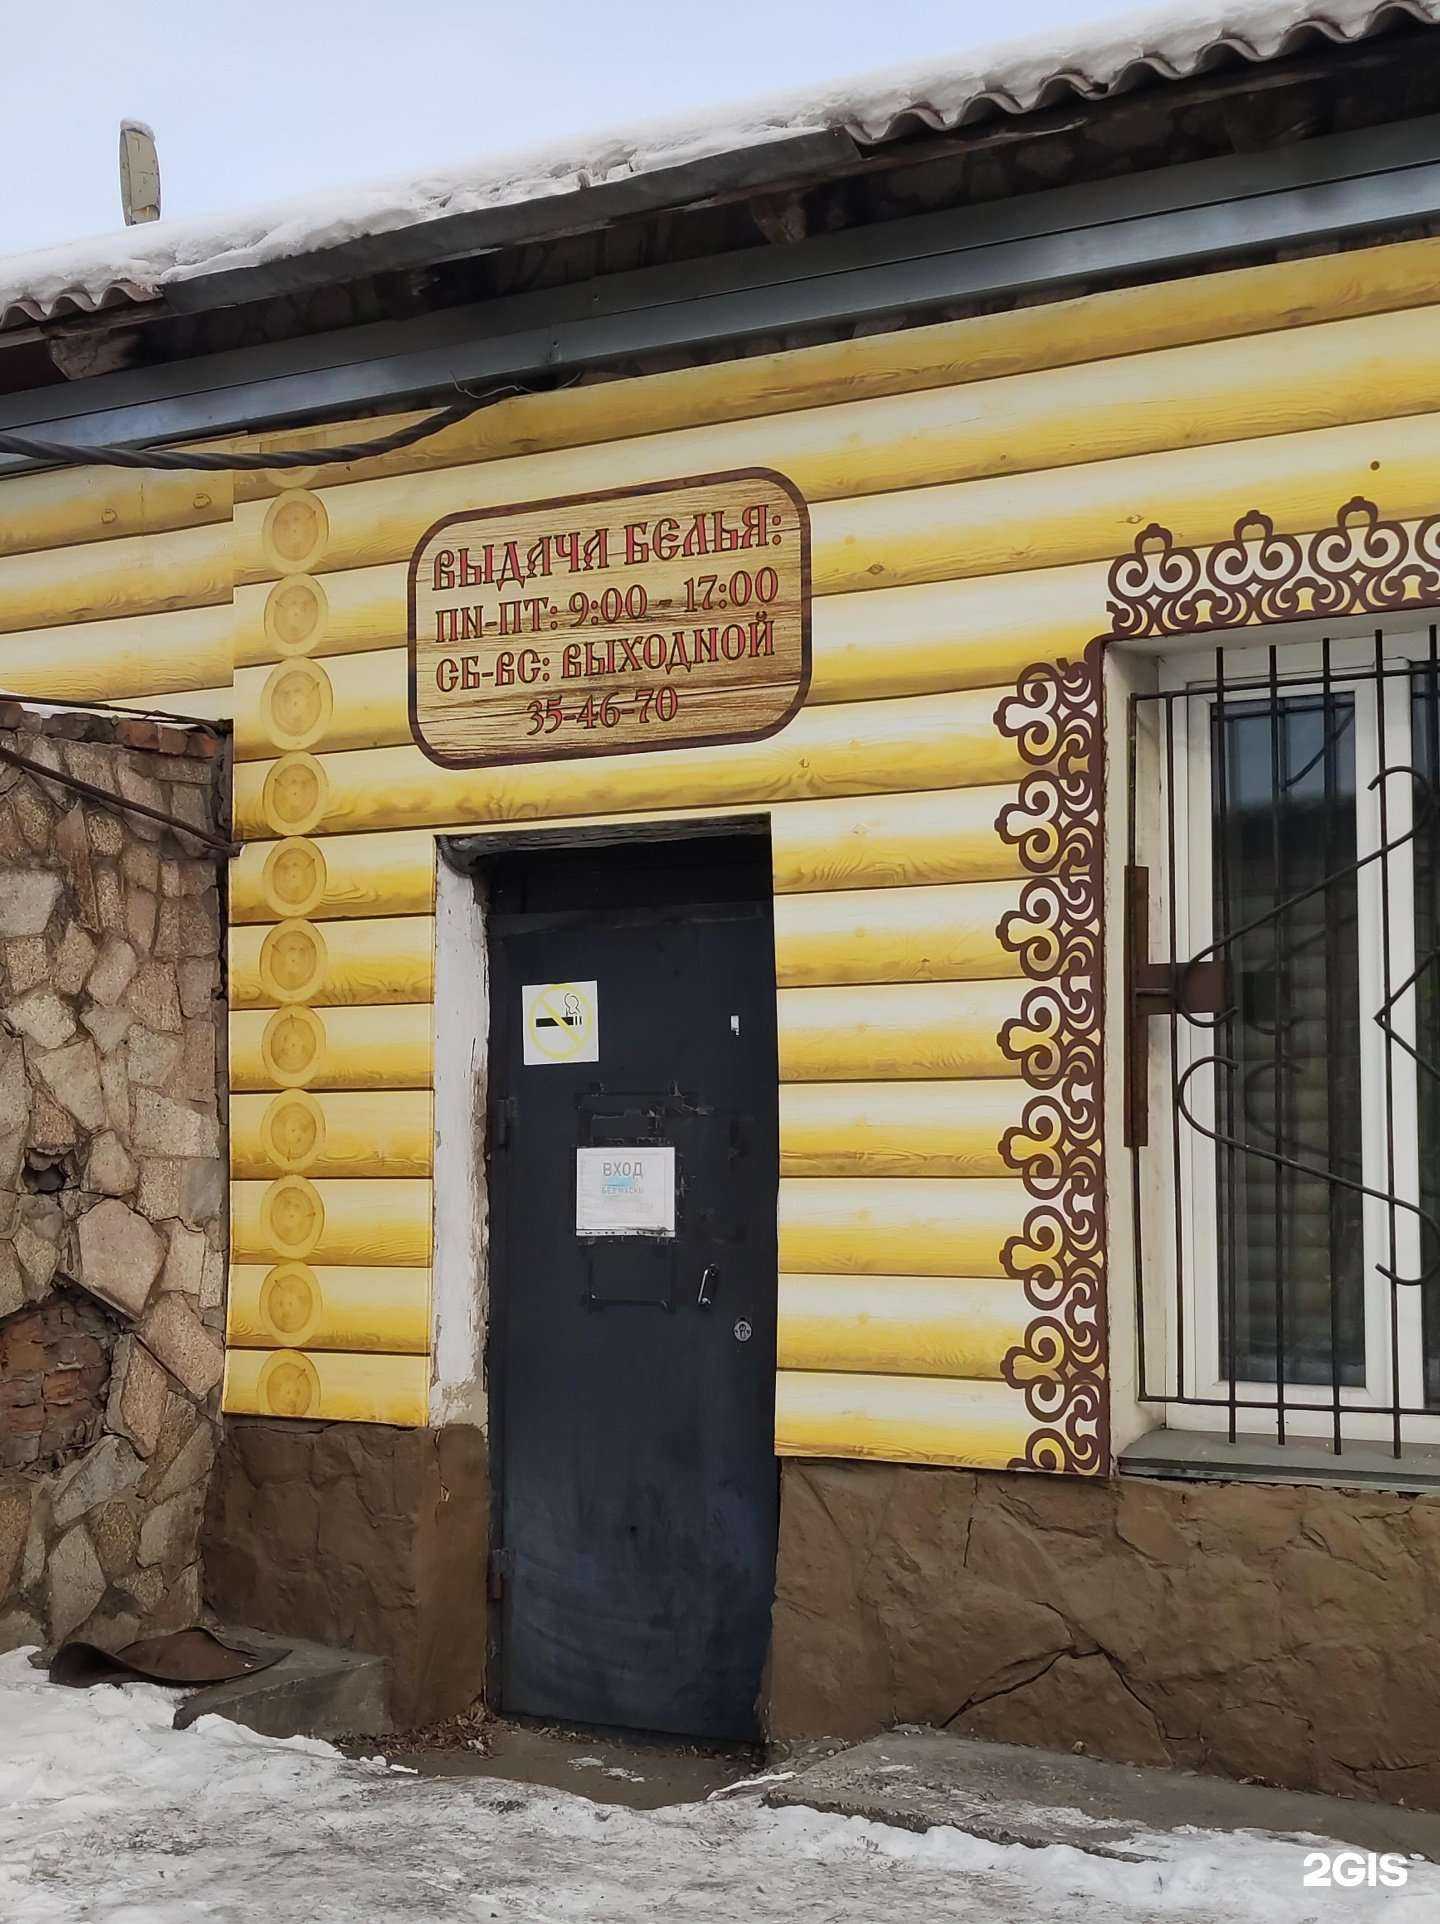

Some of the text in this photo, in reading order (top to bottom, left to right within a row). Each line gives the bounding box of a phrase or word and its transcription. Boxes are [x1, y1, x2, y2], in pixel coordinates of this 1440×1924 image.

[432, 503, 783, 591] ВЫДАЧА БЕЛЬЯ:
[435, 596, 559, 643] ПН-ПТ:
[568, 583, 648, 628] 9:00
[684, 566, 779, 613] 17:00
[435, 610, 775, 692] СБ-ВС: ВЫХОДНОЙ
[526, 686, 679, 735] 35-46-70
[603, 1162, 643, 1179] ВХОД
